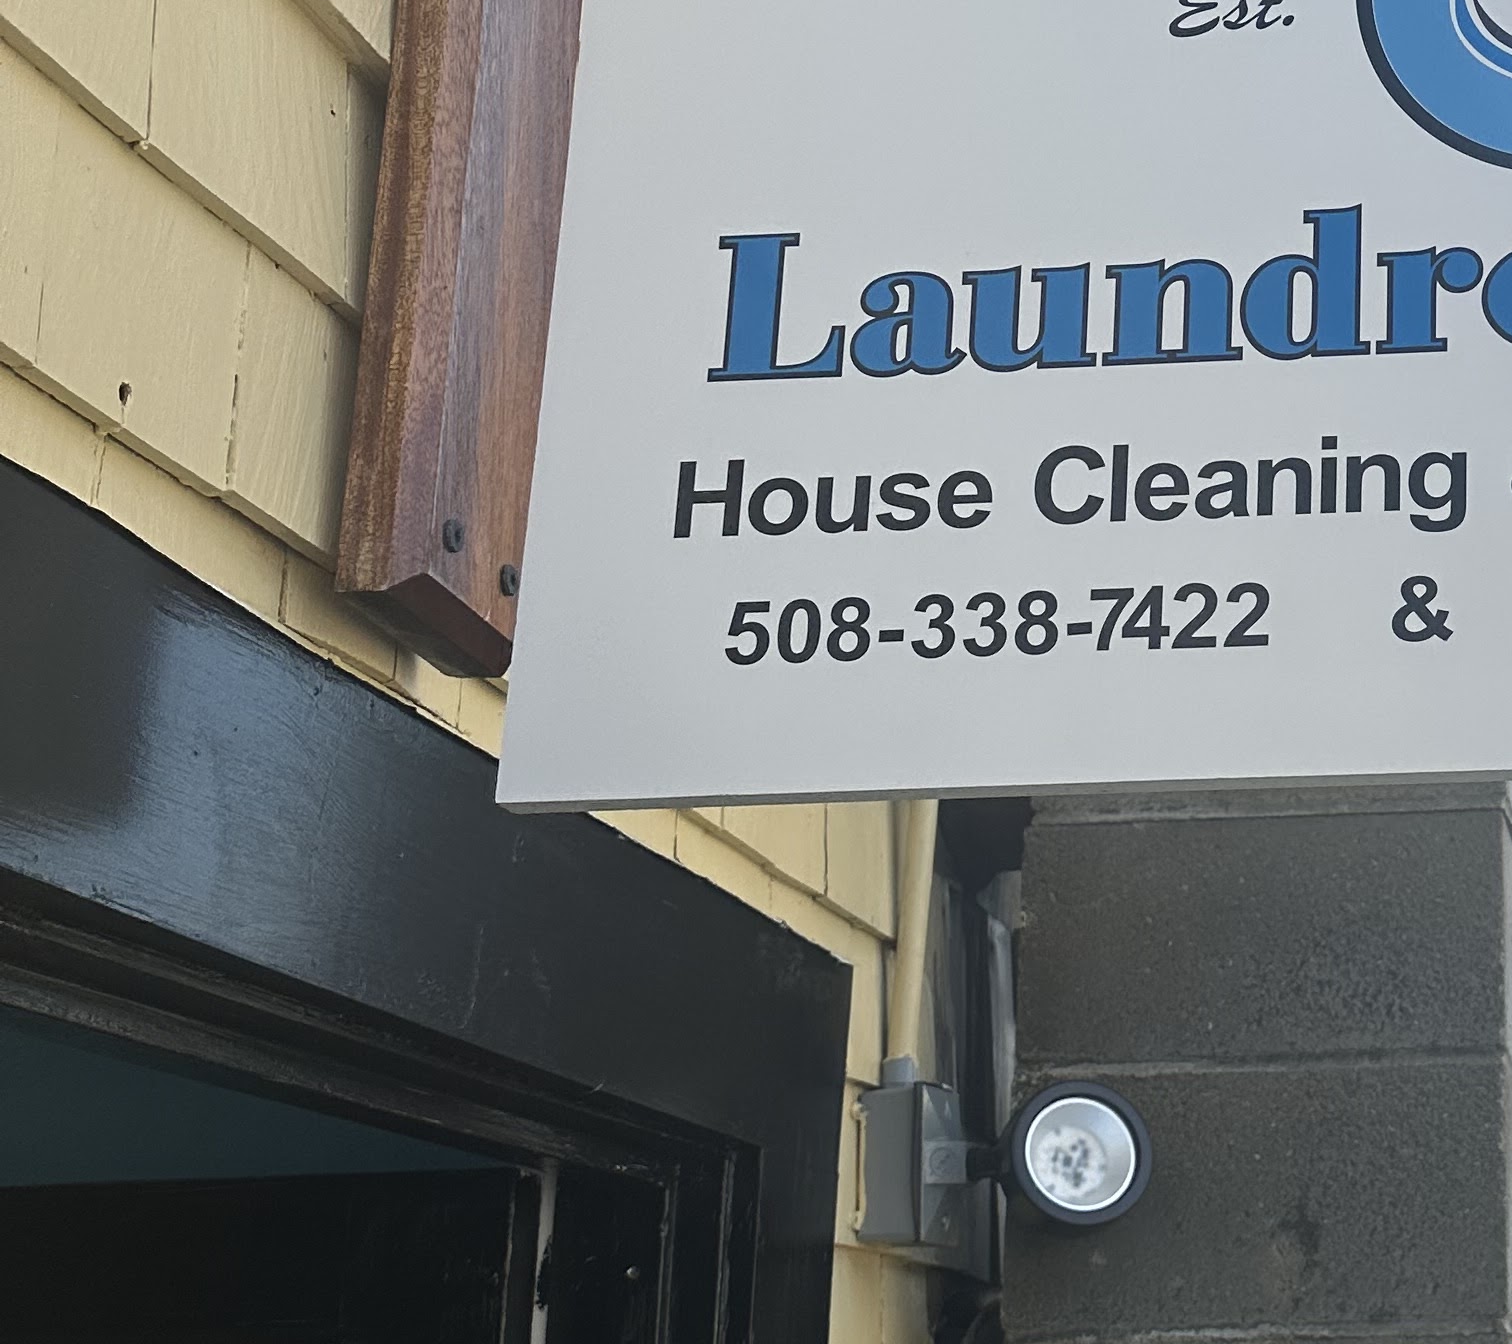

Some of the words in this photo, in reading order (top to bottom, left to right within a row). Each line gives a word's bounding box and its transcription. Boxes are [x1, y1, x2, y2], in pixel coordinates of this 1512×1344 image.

[672, 458, 994, 540] House
[1033, 435, 1468, 533] Cleaning
[724, 581, 1271, 666] 508-338-7422
[1391, 574, 1455, 643] &
